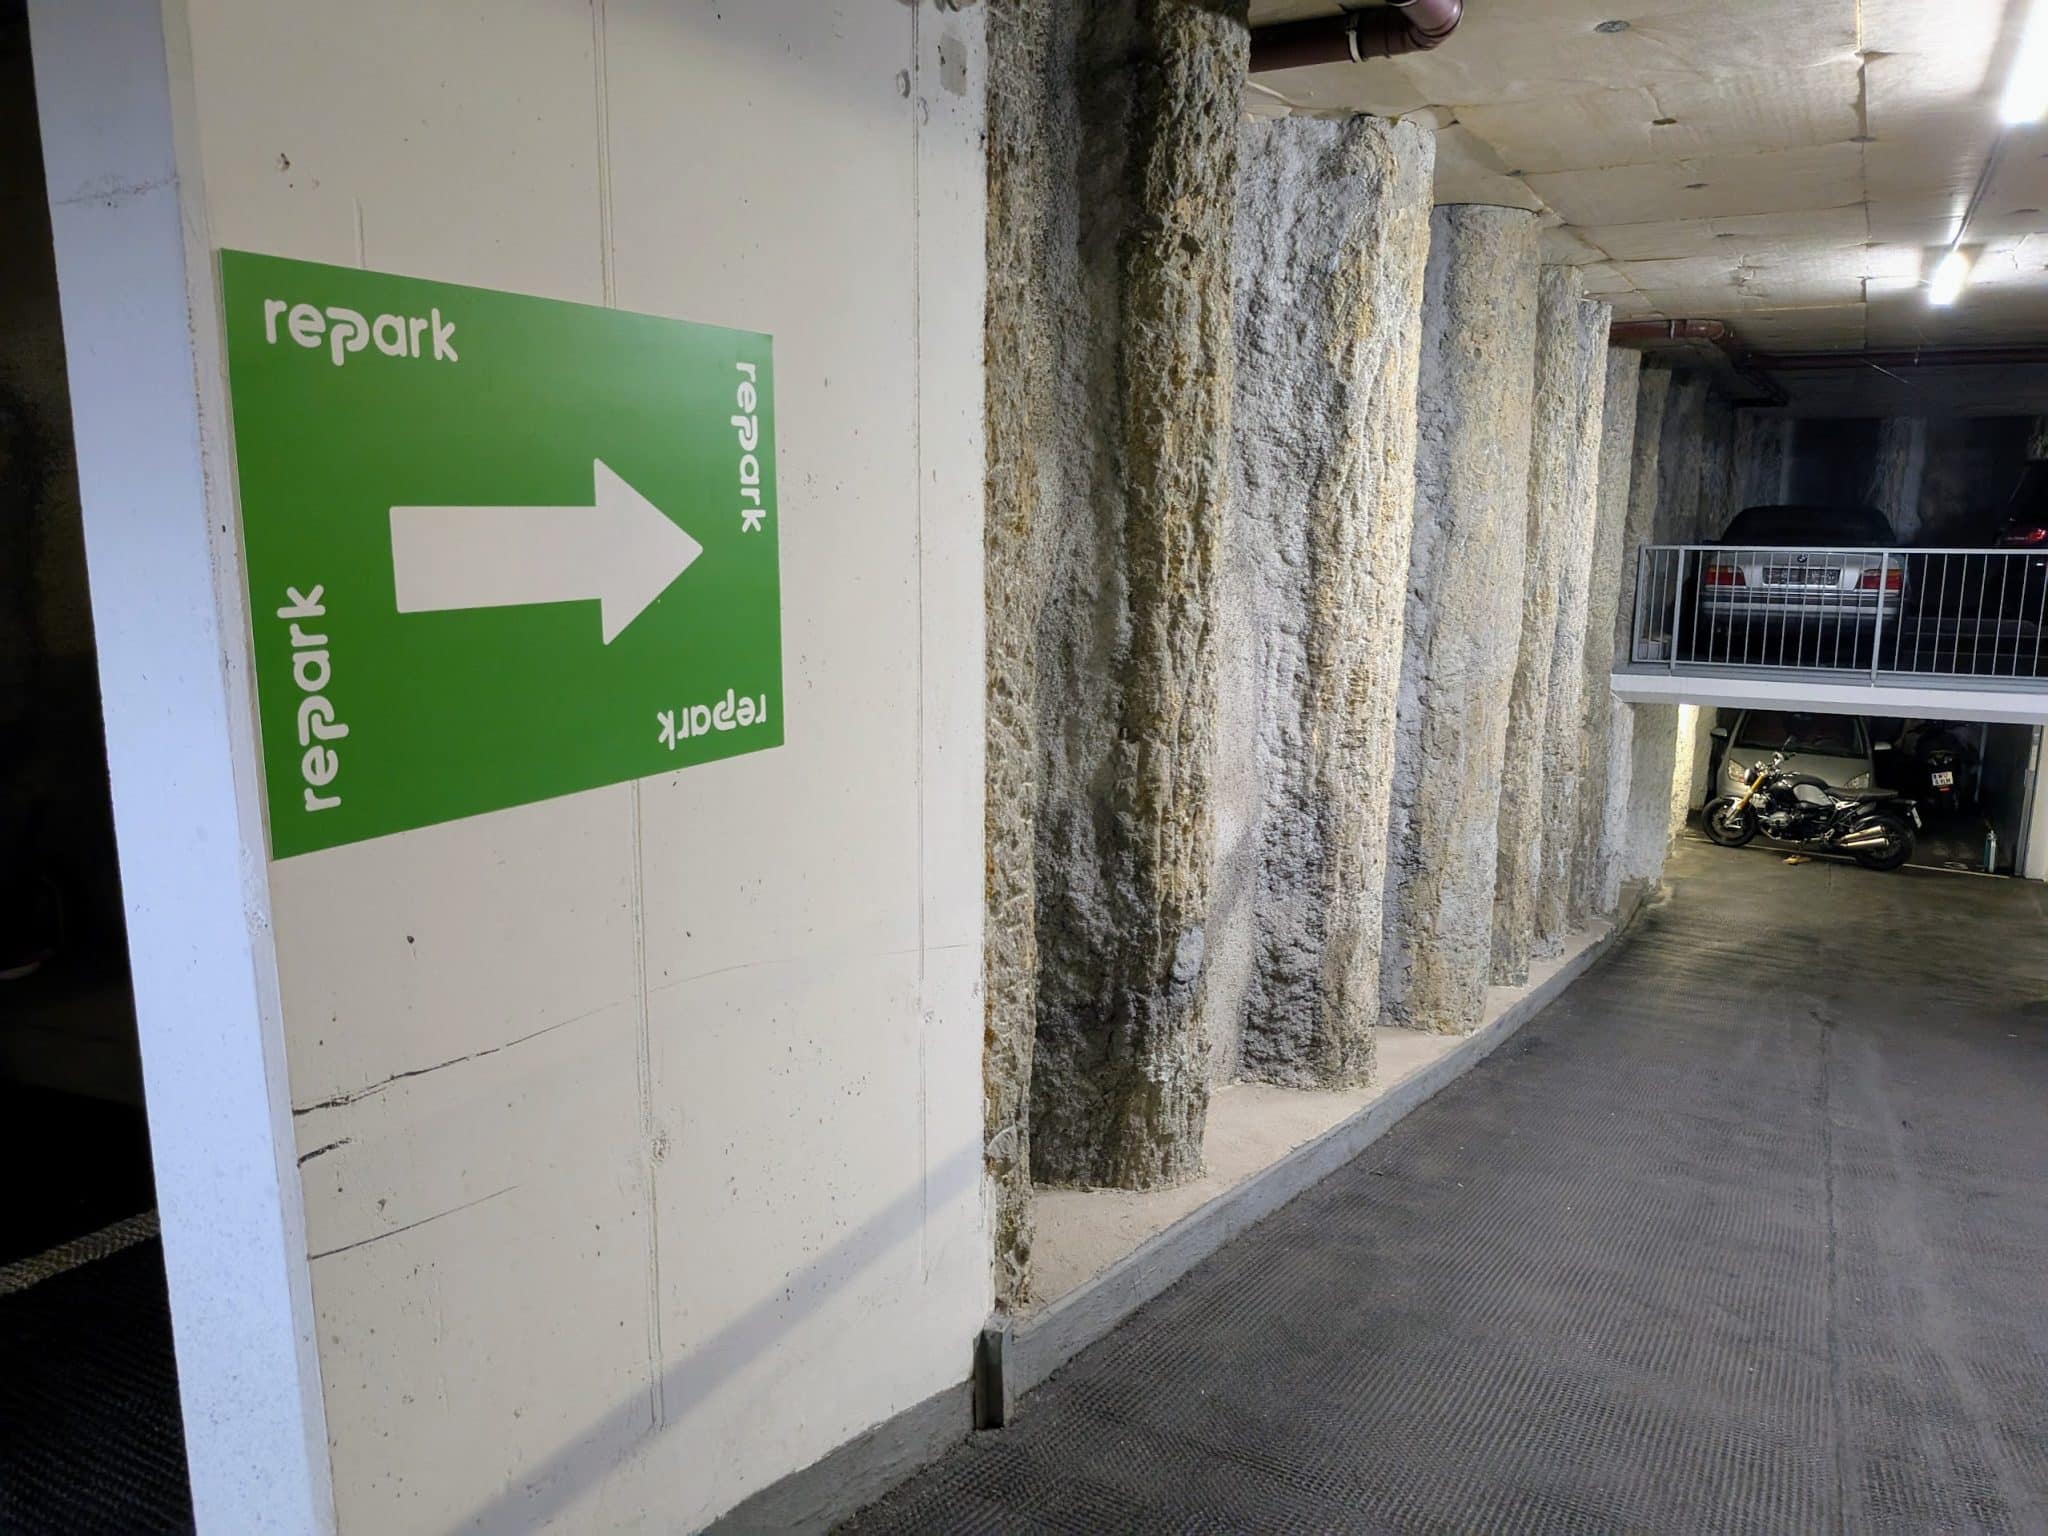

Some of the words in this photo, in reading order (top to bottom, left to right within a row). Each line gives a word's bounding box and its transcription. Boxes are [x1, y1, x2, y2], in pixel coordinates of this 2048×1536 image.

[264, 299, 459, 366] repark
[730, 361, 767, 534] repark
[277, 584, 349, 812] repark
[657, 688, 767, 751] repark
